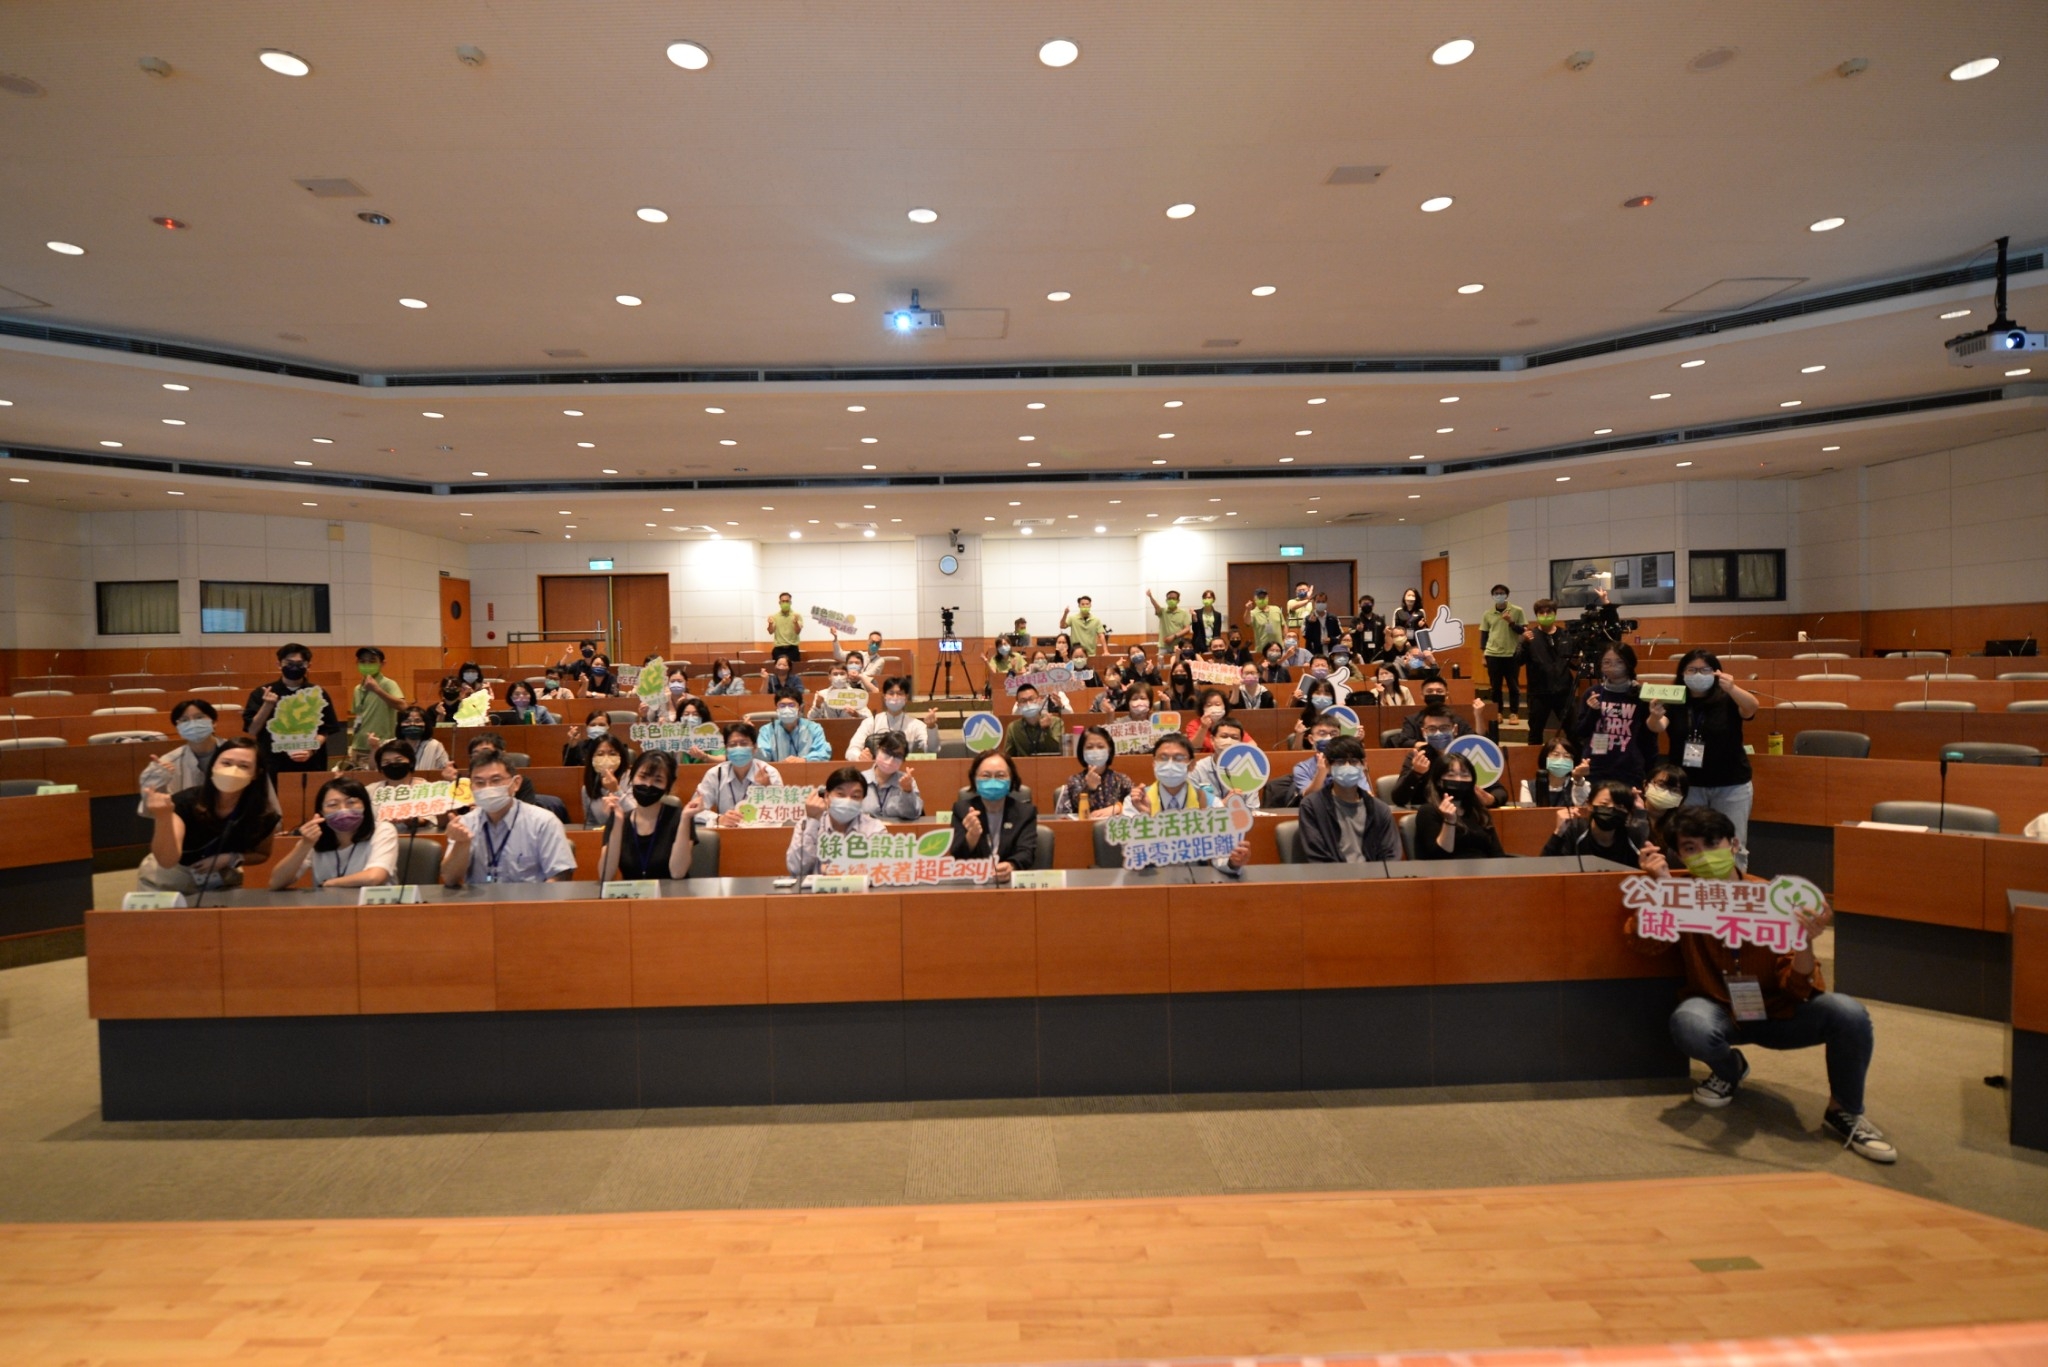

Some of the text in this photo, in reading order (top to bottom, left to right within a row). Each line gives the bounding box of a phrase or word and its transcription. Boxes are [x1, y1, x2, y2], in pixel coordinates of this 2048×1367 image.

[375, 782, 448, 802] 綠色消費
[1108, 809, 1230, 843] 綠生活我行
[819, 833, 918, 859] 綠色設計
[1624, 880, 1769, 915] 公正轉型
[1641, 908, 1807, 951] 缺一不可!
